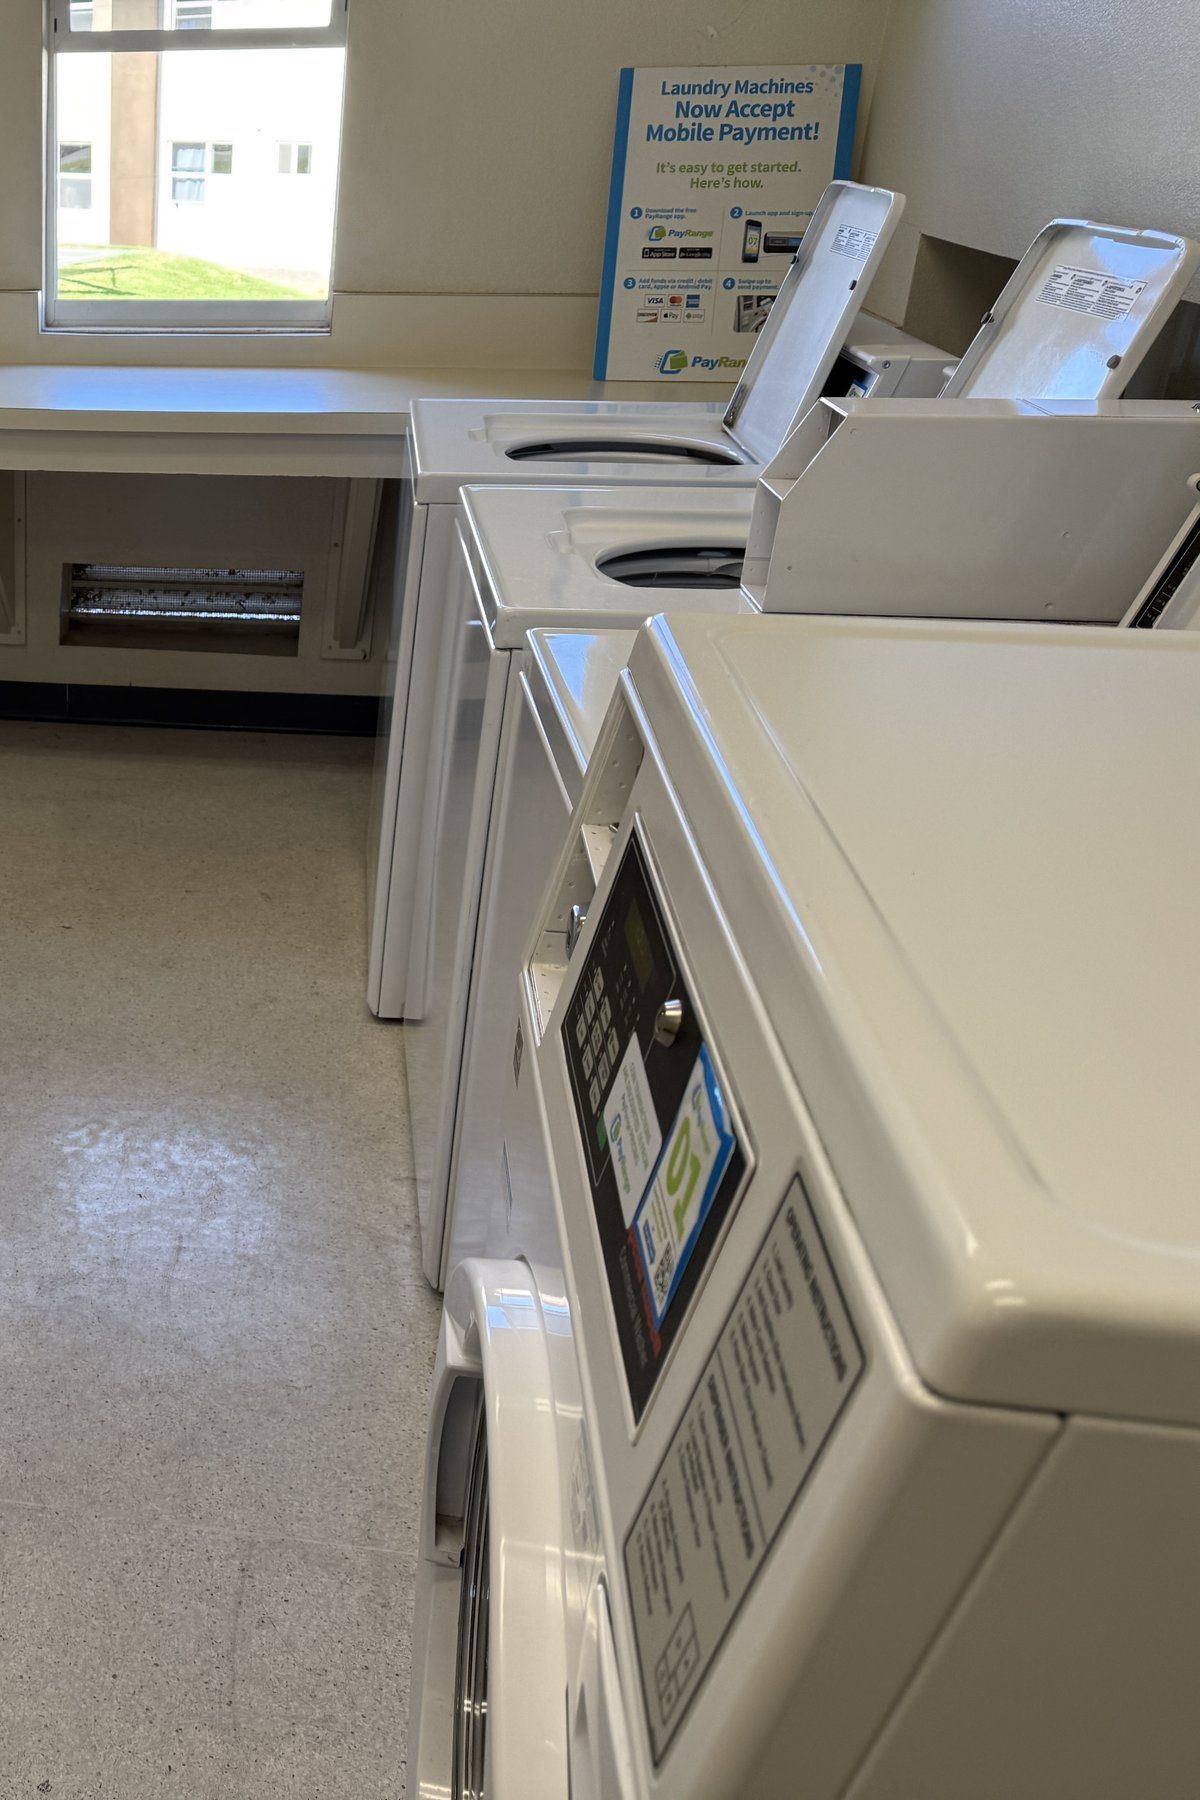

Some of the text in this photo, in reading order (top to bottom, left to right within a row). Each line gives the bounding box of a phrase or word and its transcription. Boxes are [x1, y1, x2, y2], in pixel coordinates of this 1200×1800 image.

[662, 78, 814, 98] Laundry Machines
[675, 100, 795, 121] Now Accept
[646, 122, 820, 145] Mobile Payment!
[656, 161, 802, 176] It's easy to get started.
[690, 177, 764, 189] Here's how.
[668, 229, 713, 239] PayRange
[668, 312, 679, 320] Pay
[691, 356, 747, 370] PayRan
[616, 1137, 631, 1194] PayRange
[667, 1116, 702, 1243] 01
